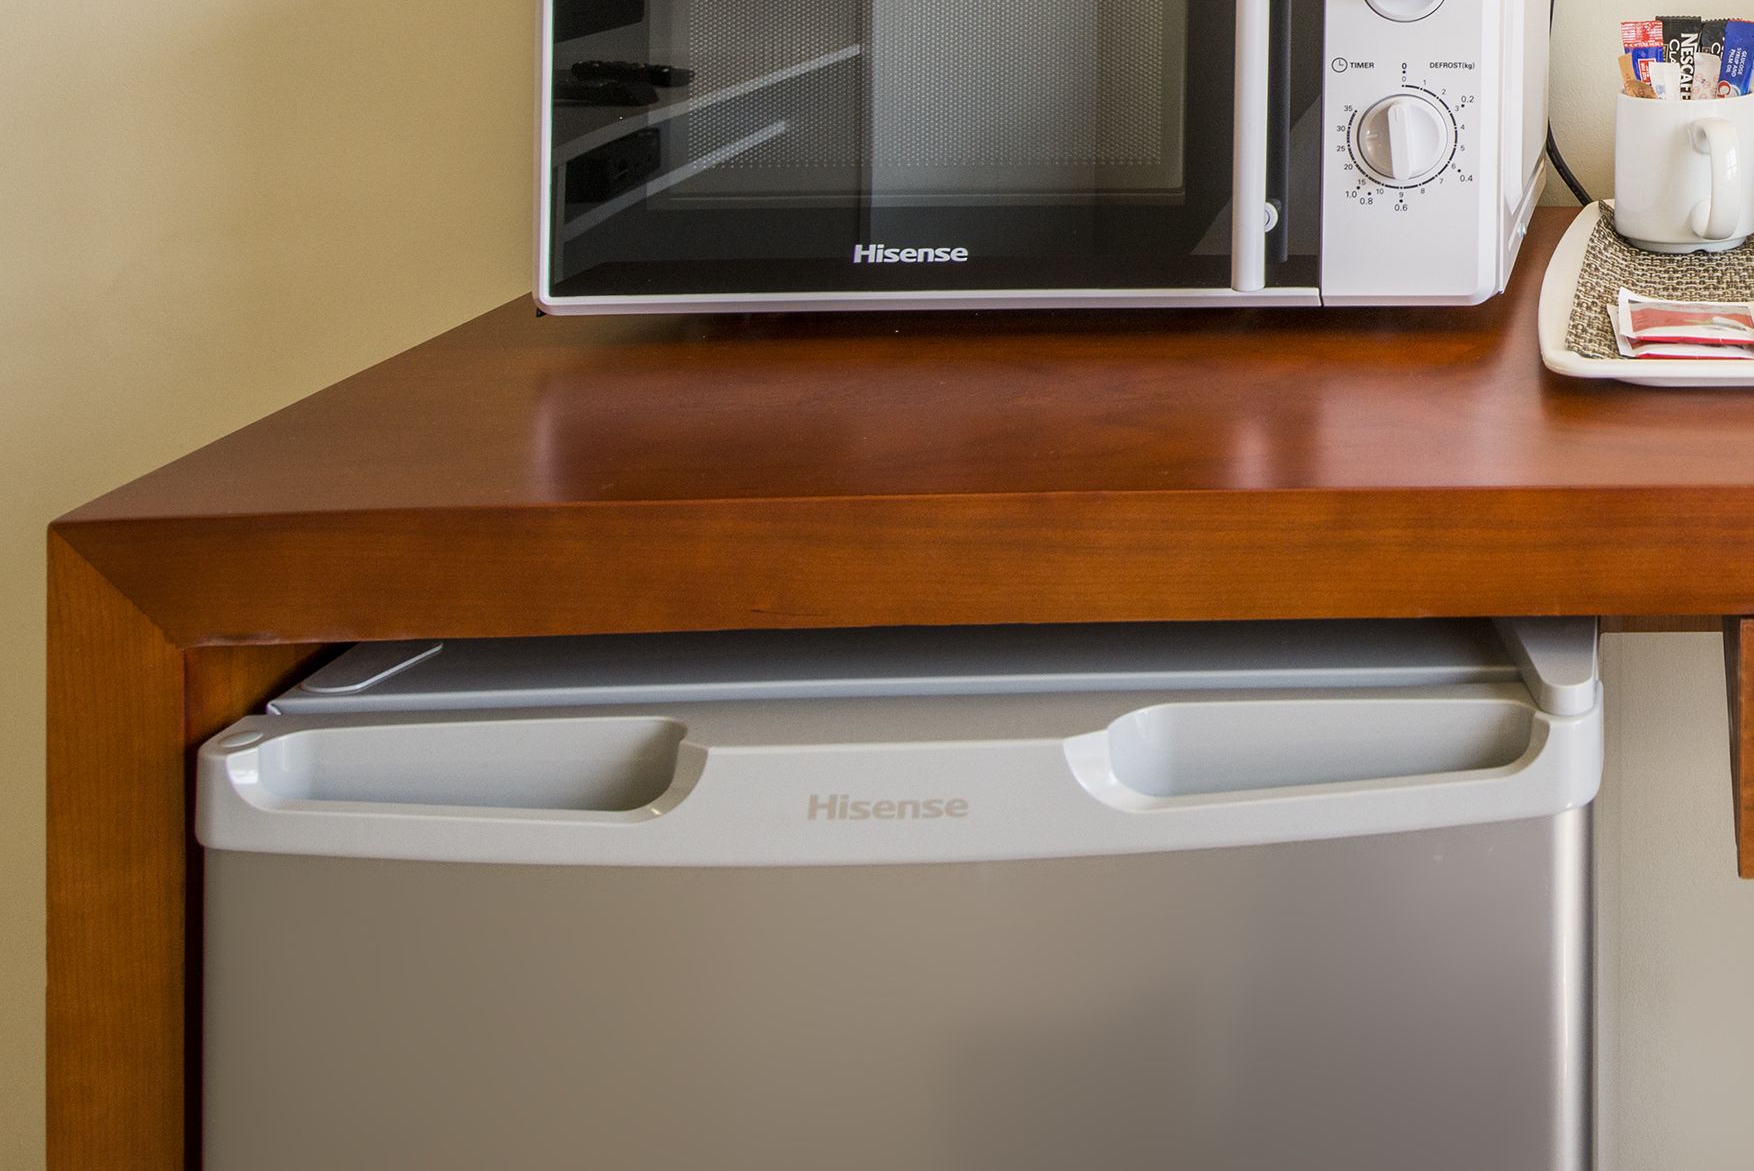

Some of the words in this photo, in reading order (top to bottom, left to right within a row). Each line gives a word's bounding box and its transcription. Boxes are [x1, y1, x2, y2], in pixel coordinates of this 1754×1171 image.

[1728, 49, 1736, 64] PALM
[1734, 47, 1742, 65] SYRUP
[1349, 61, 1375, 70] TIMER
[1429, 61, 1476, 71] DEFROST(kg)
[1738, 50, 1747, 75] GLUCOSE
[1460, 95, 1475, 105] 0.2
[1343, 105, 1355, 113] 35
[1336, 125, 1347, 133] 30
[1336, 145, 1346, 153] 25
[1343, 163, 1354, 171] 20
[1357, 178, 1367, 187] 15
[1459, 174, 1474, 183] 0.4
[1345, 190, 1358, 199] 1.0
[1375, 188, 1385, 196] 10
[1359, 197, 1374, 206] 0.8
[1393, 204, 1409, 212] 0.6
[853, 243, 969, 264] Hisense
[807, 794, 969, 821] Hisense
